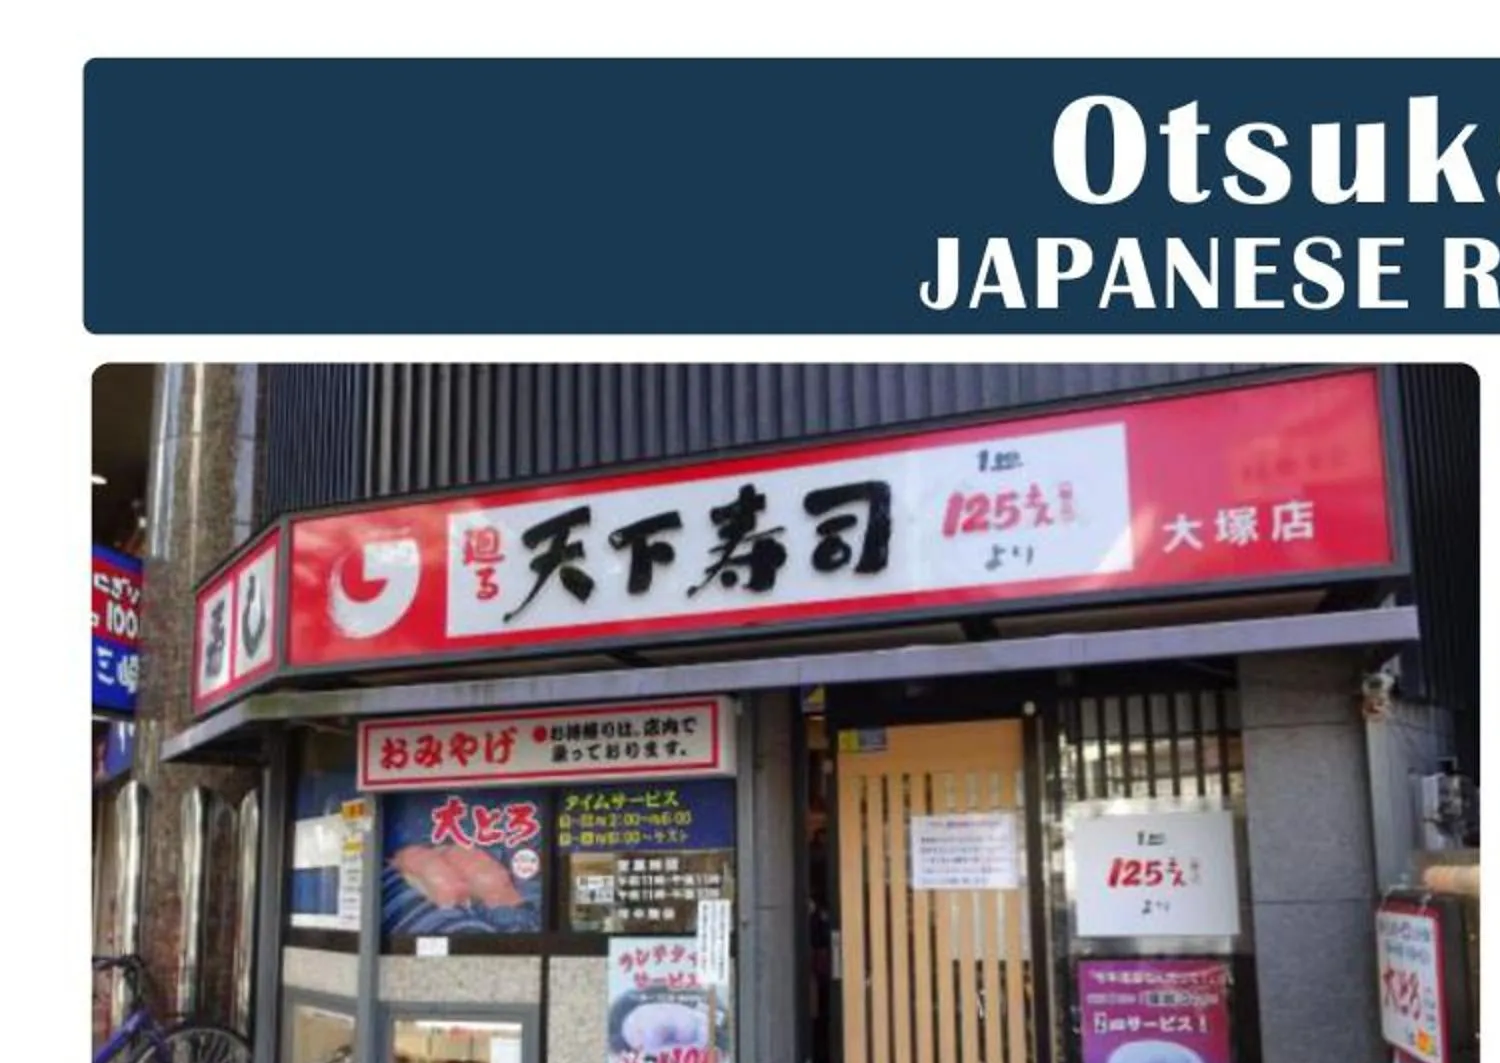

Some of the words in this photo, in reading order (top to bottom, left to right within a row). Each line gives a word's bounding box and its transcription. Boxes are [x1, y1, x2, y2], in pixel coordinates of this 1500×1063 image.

[503, 480, 893, 622] 天下寿司
[1163, 501, 1316, 553] 大塚店
[381, 728, 518, 770] おみやげ
[432, 795, 540, 849] 大とろ
